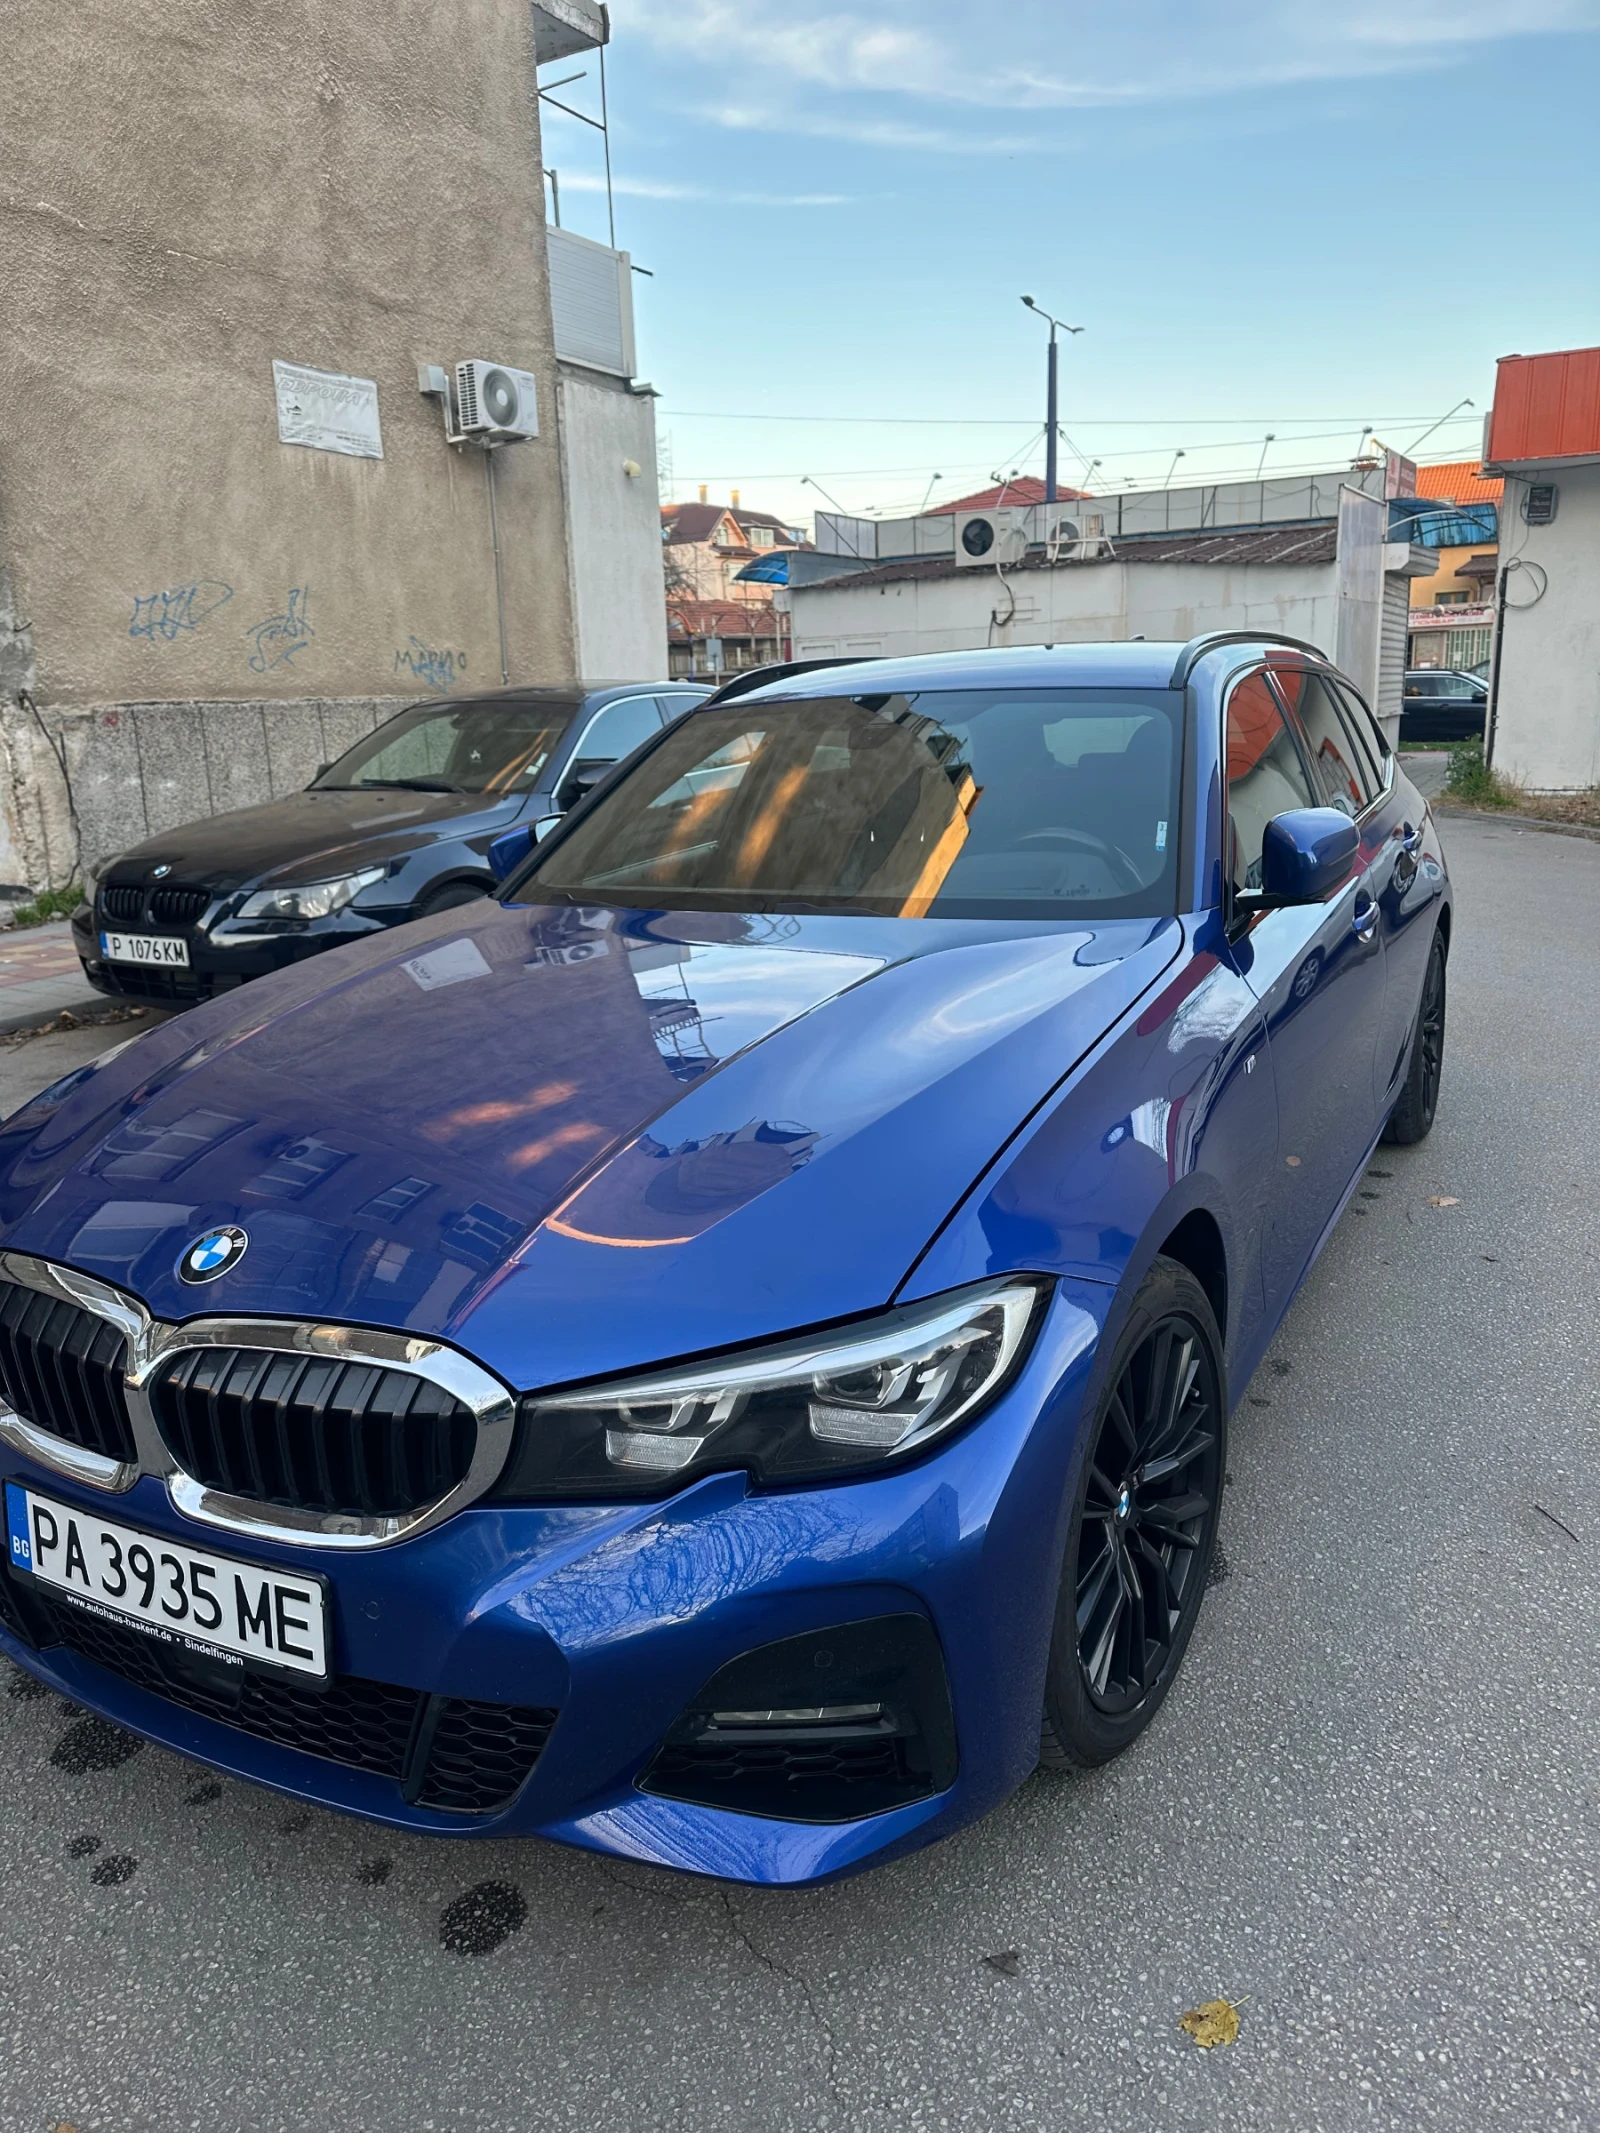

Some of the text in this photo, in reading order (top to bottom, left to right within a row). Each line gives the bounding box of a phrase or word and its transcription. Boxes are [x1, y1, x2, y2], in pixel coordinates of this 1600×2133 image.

[278, 378, 361, 405] ЕВРОПА
[112, 937, 121, 956] P
[12, 1535, 30, 1558] BG
[100, 1532, 223, 1630] 3935
[234, 1574, 314, 1661] ME
[184, 1637, 244, 1666] Sindelfingen
